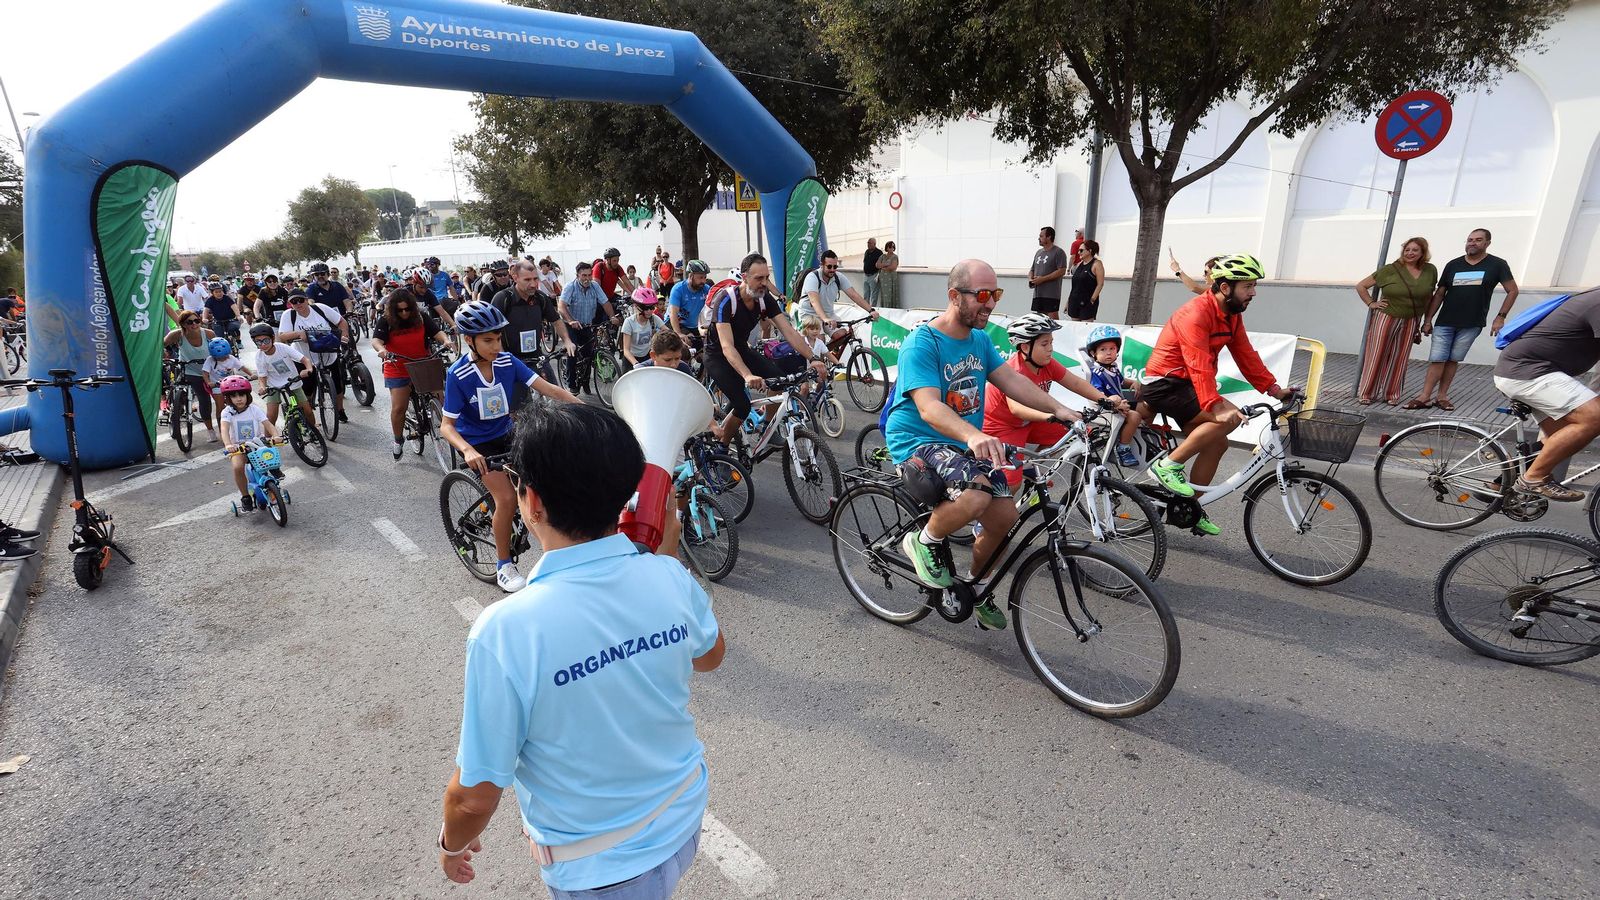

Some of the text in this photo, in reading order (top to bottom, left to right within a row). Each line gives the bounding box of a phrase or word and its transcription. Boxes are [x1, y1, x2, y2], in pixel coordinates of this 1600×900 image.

[401, 15, 666, 59] Ayuntamiento de Jerez
[402, 32, 491, 53] Deportes
[553, 623, 689, 687] ORGANZACIÓN
